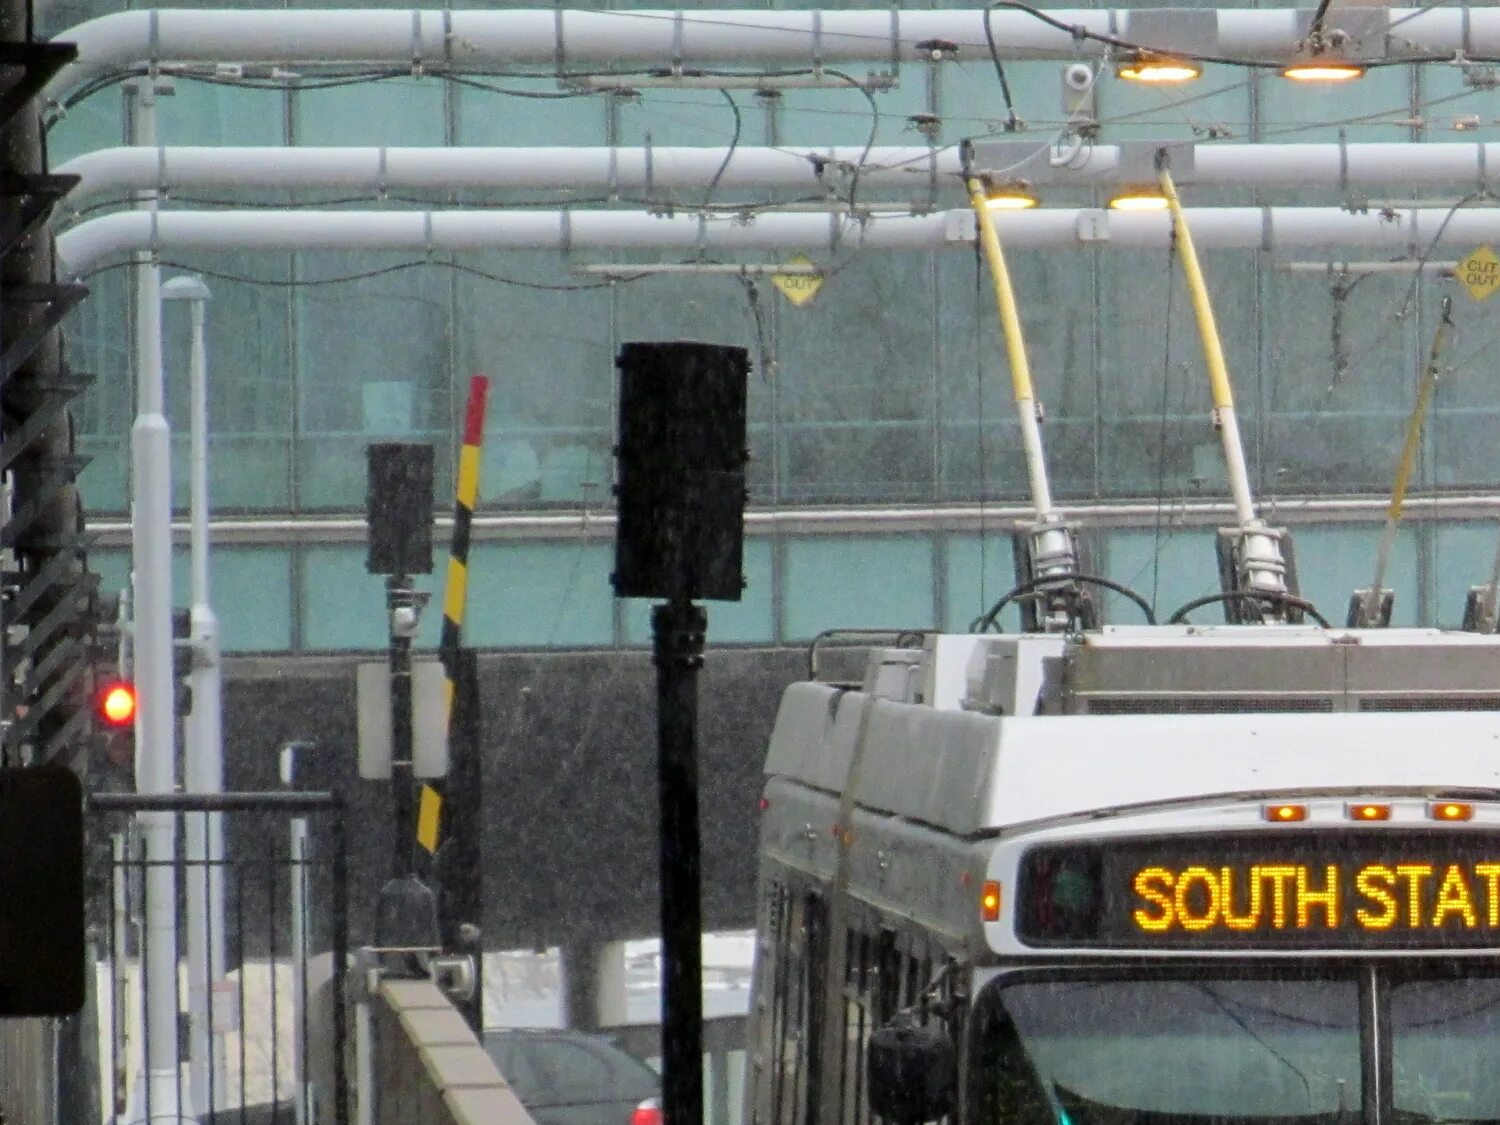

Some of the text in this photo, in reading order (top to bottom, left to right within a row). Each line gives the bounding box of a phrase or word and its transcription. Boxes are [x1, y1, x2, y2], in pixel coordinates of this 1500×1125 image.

[1467, 260, 1498, 273] CUT
[1466, 272, 1498, 286] OUT
[1133, 865, 1338, 930] SOUTH
